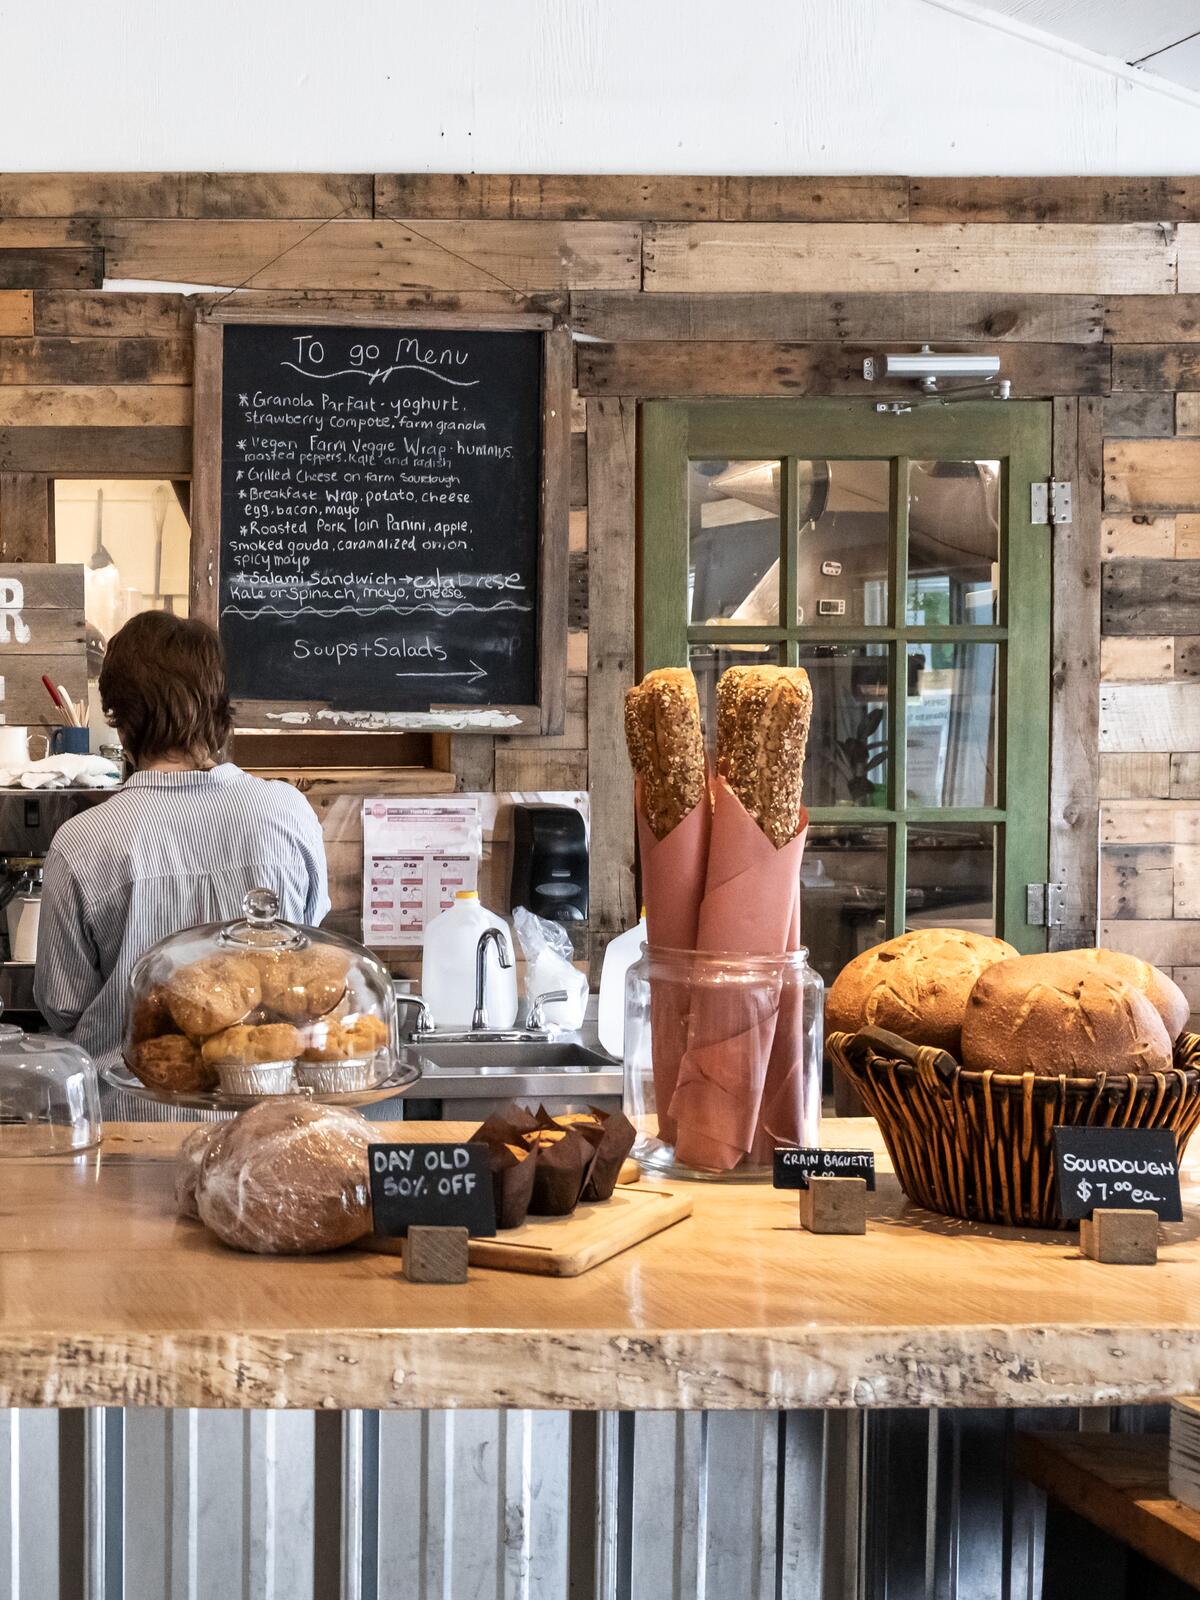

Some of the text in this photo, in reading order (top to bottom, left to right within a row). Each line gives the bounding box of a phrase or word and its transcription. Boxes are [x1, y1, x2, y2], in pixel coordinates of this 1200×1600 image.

[349, 344, 379, 365] go
[395, 338, 469, 365] Menu
[253, 391, 314, 408] Granola
[399, 415, 433, 429] farm
[436, 420, 486, 435] granola
[251, 436, 298, 451] Vegan
[310, 435, 346, 451] Farm
[352, 438, 396, 458] Veggie
[384, 457, 408, 466] and
[248, 467, 291, 482] Grilled
[344, 473, 360, 482] on
[364, 472, 394, 482] farm
[250, 487, 317, 500] Breakfast
[325, 505, 359, 520] mayo
[250, 521, 307, 535] Roasted
[229, 540, 283, 551] smoked
[250, 571, 304, 584] Salami
[307, 572, 395, 586] Sandwich
[374, 1148, 470, 1172] DAY OLD
[783, 1153, 874, 1168] GRAIN BAGUETTE
[1064, 1153, 1175, 1176] SOURDOUGH
[383, 1173, 476, 1197] 50% OFF
